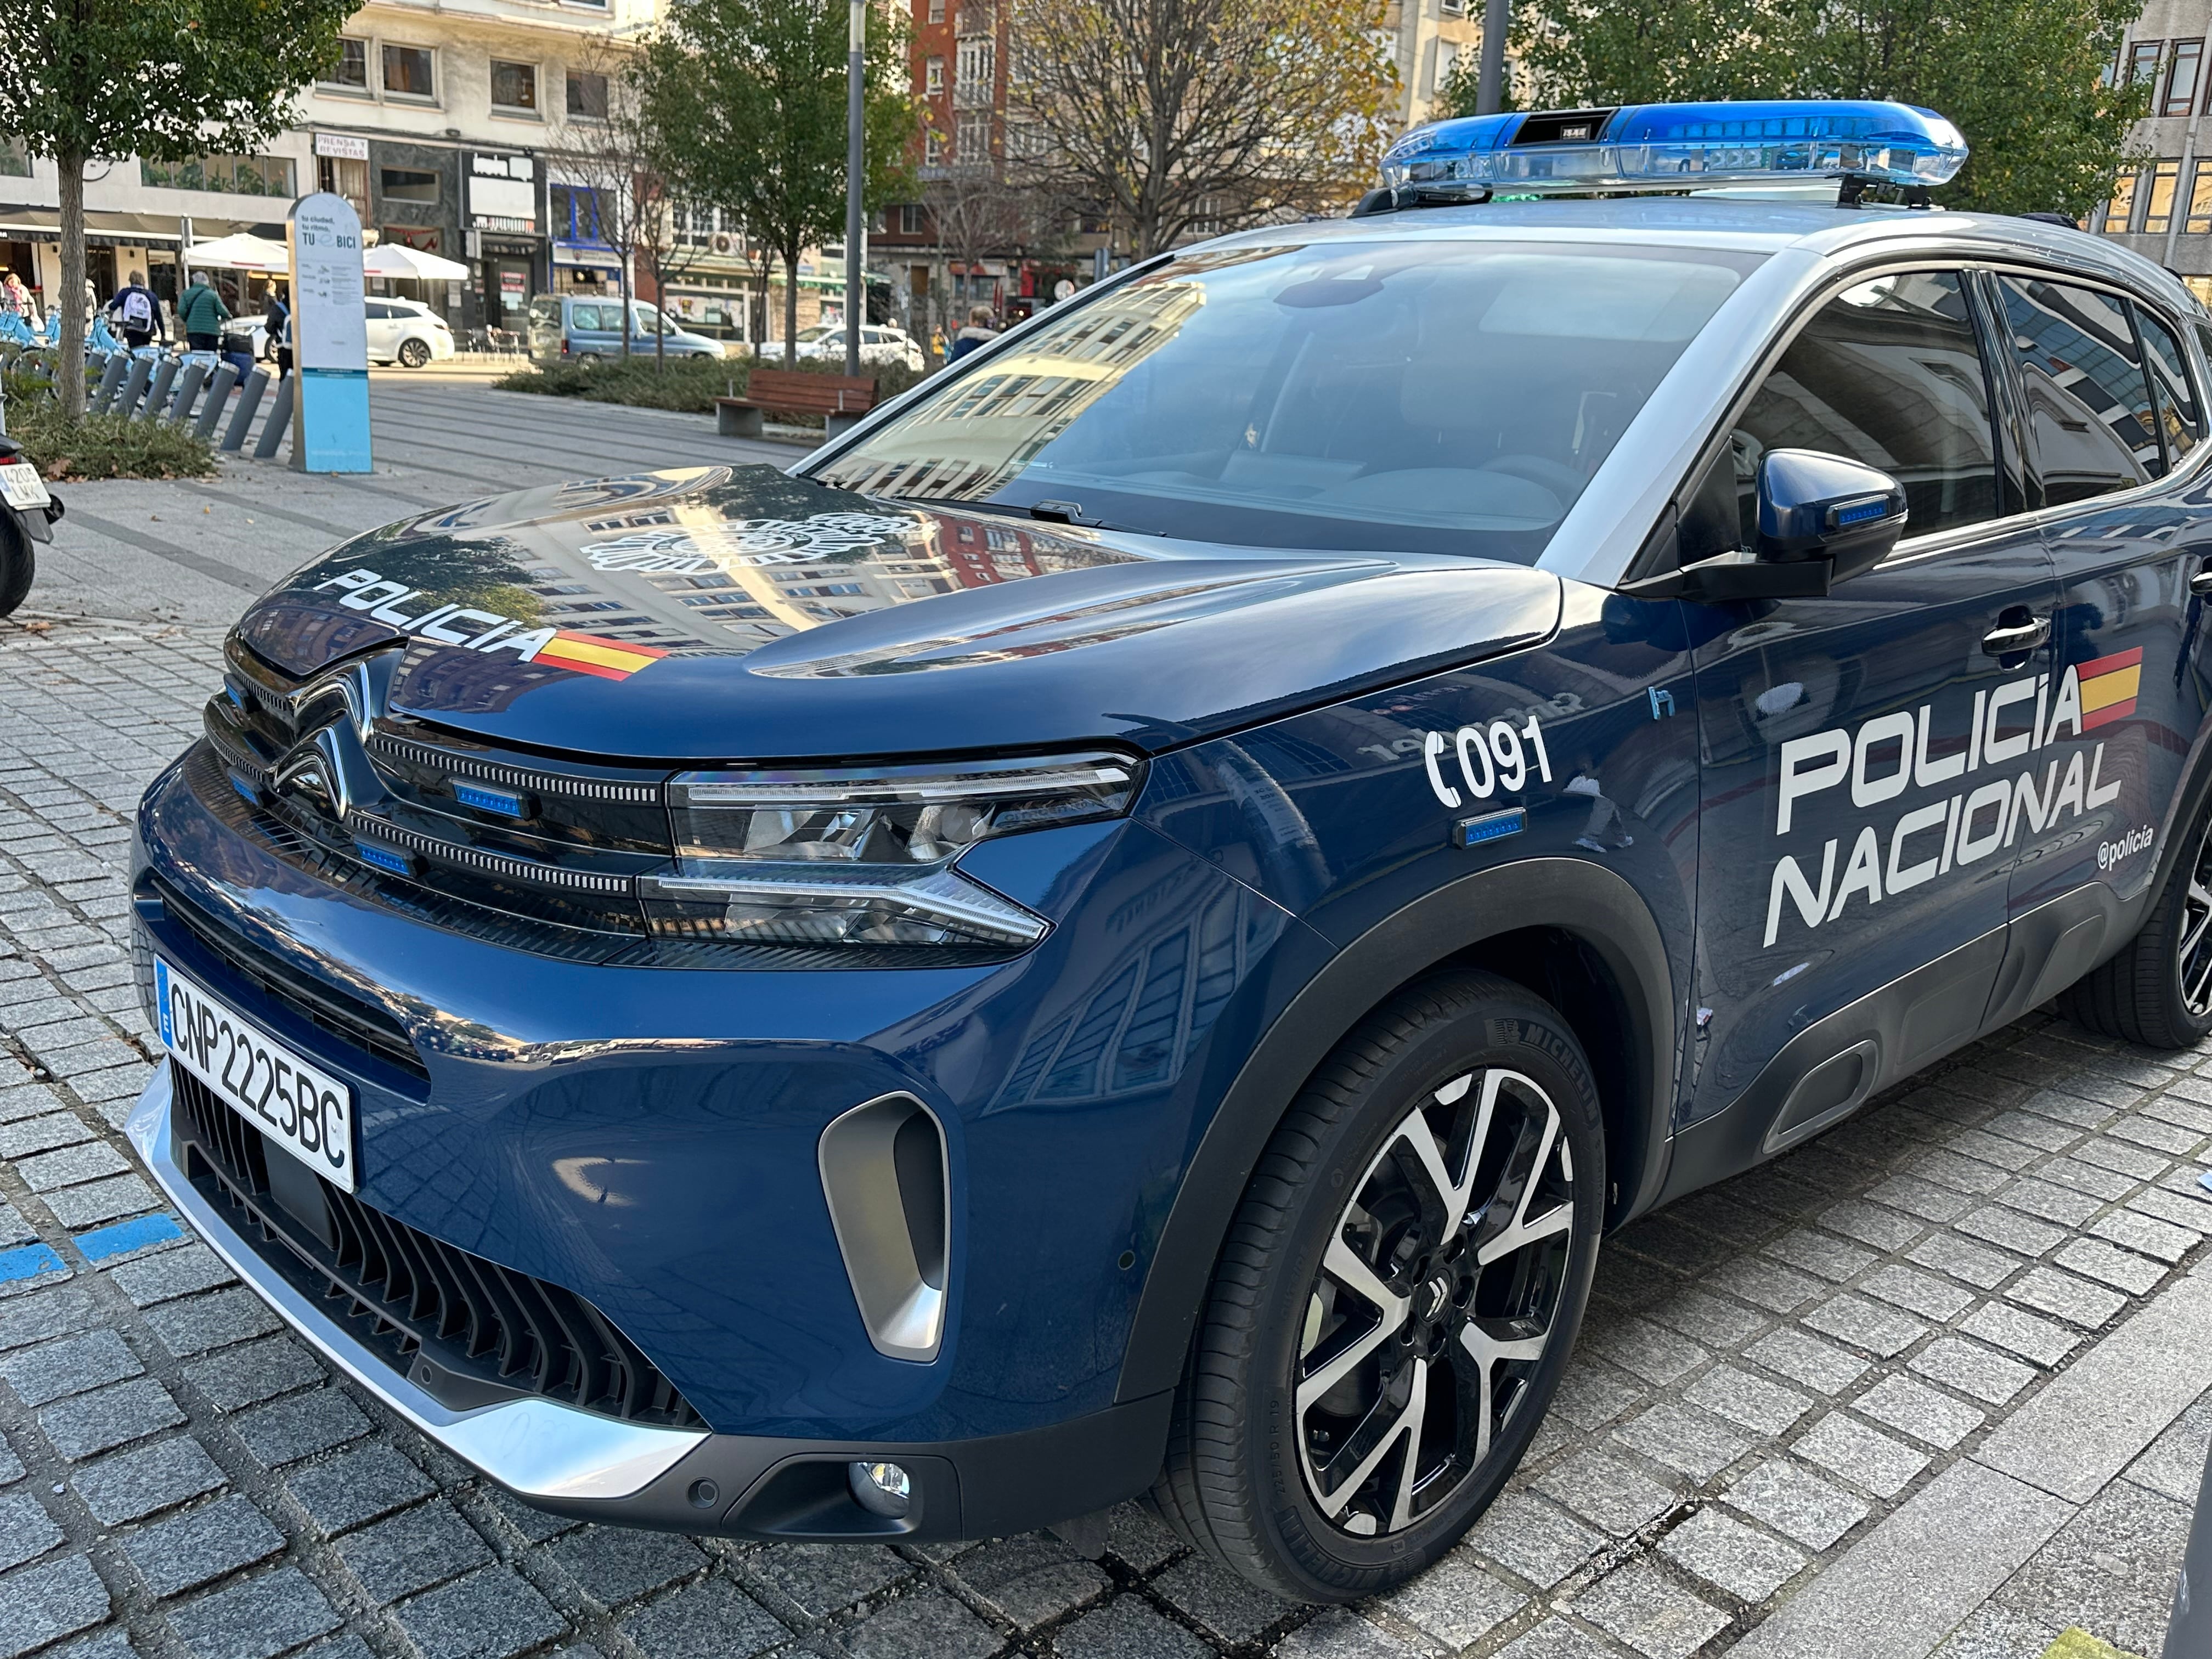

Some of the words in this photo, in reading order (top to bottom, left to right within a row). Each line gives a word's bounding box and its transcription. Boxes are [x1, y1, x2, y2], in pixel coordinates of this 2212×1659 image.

[318, 136, 356, 147] PRENSA
[320, 145, 364, 157] REVISTAS
[302, 232, 315, 246] TU
[336, 235, 356, 249] BICI
[1456, 715, 1553, 798] 091
[1763, 742, 2121, 948] NACIONAL
[171, 983, 345, 1169] CNP2225BC
[1524, 1024, 1599, 1121] MICHELIN
[1268, 1399, 1280, 1417] 19
[1269, 1441, 1286, 1496] 225/50
